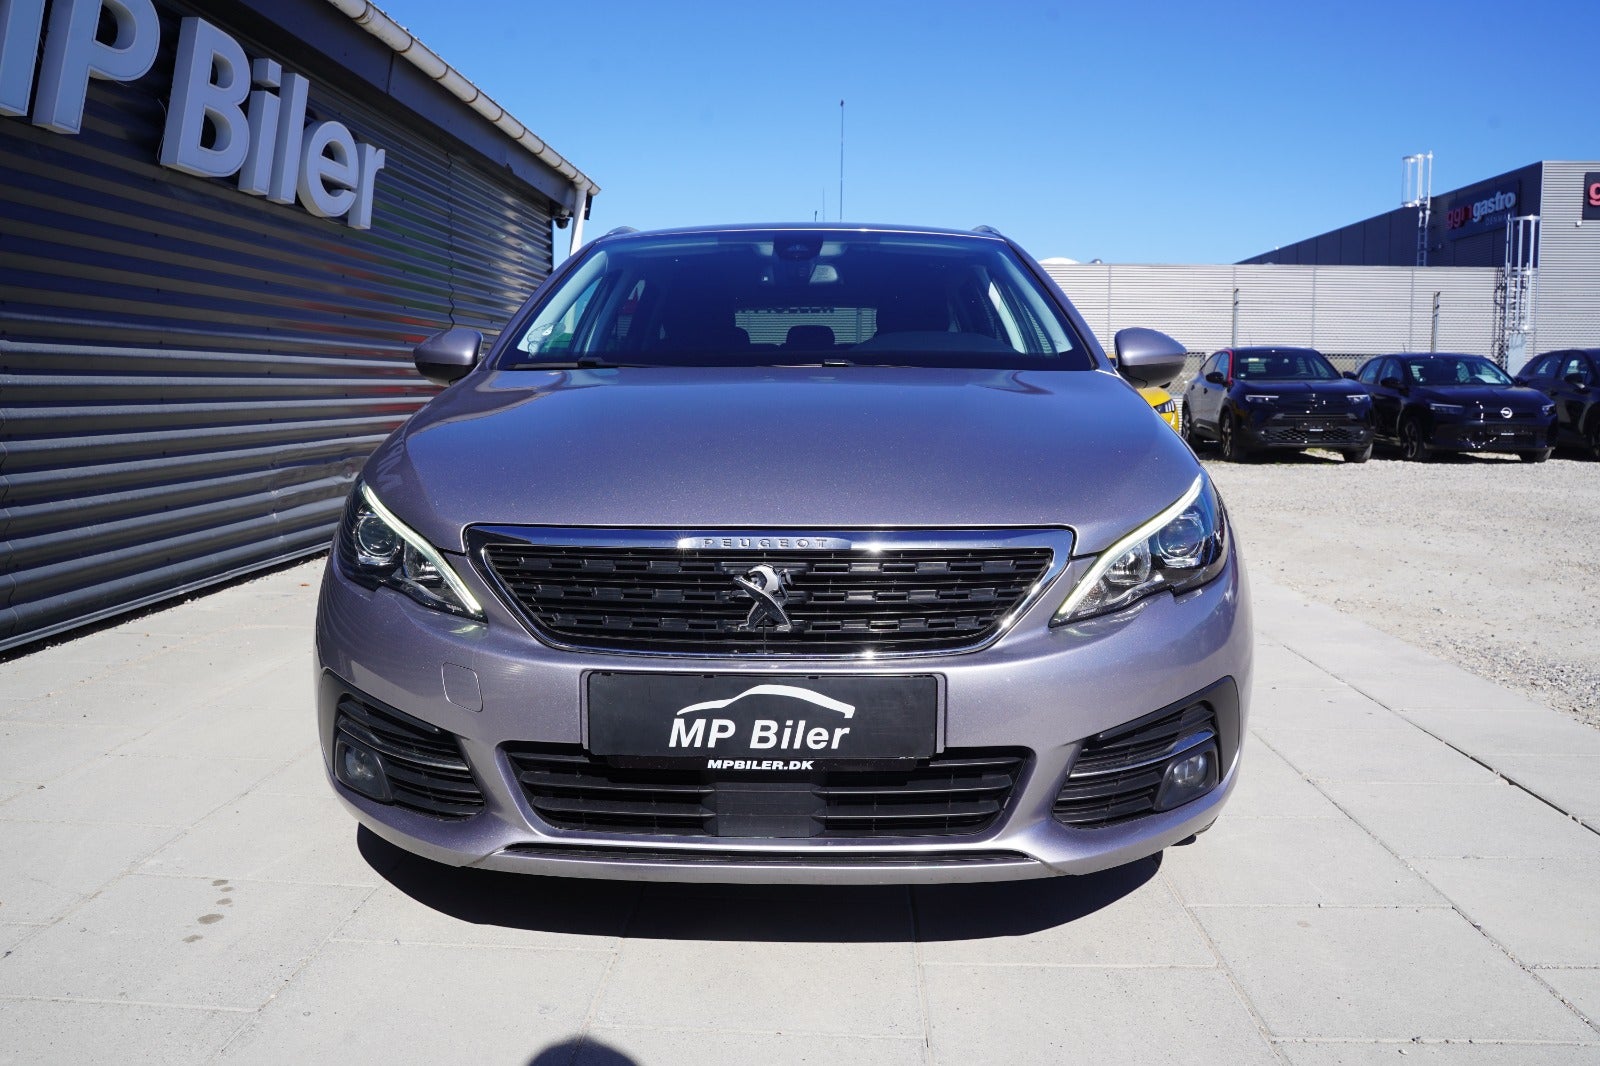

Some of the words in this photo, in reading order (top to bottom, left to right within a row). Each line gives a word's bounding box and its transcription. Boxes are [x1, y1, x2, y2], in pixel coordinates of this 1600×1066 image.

[160, 17, 385, 230] Biler
[703, 538, 828, 548] PEUGEOT
[668, 718, 736, 748] MP
[749, 719, 850, 750] Biler
[707, 759, 815, 770] MPBILER.DK
